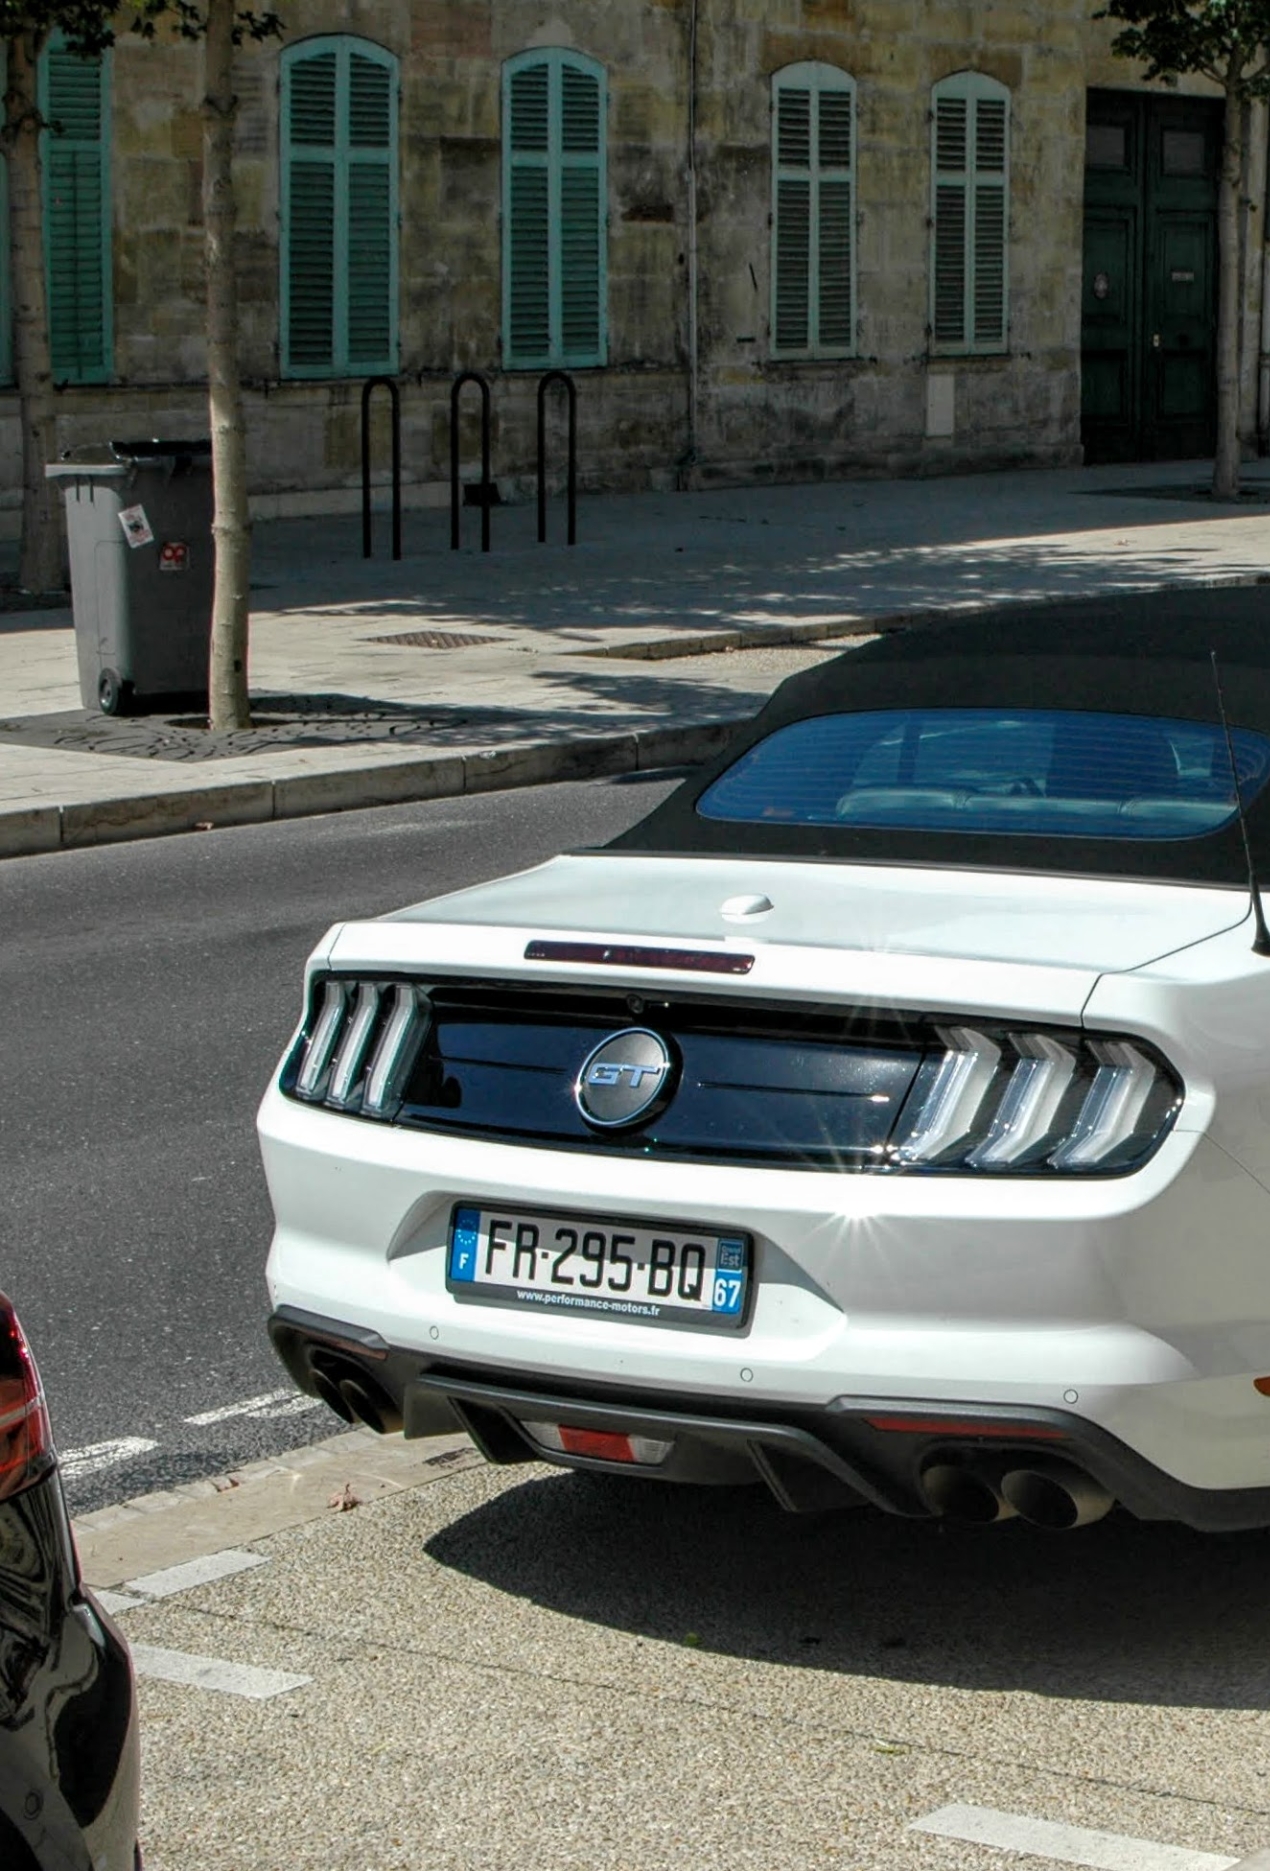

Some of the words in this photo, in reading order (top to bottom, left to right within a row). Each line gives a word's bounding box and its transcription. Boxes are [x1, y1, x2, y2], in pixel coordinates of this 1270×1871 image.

[588, 1063, 660, 1088] GT
[458, 1253, 469, 1270] F
[484, 1218, 706, 1303] FR-295-BQ
[720, 1251, 740, 1268] Est
[516, 1289, 661, 1317] www.performance-motors.fr
[714, 1277, 741, 1308] 67
